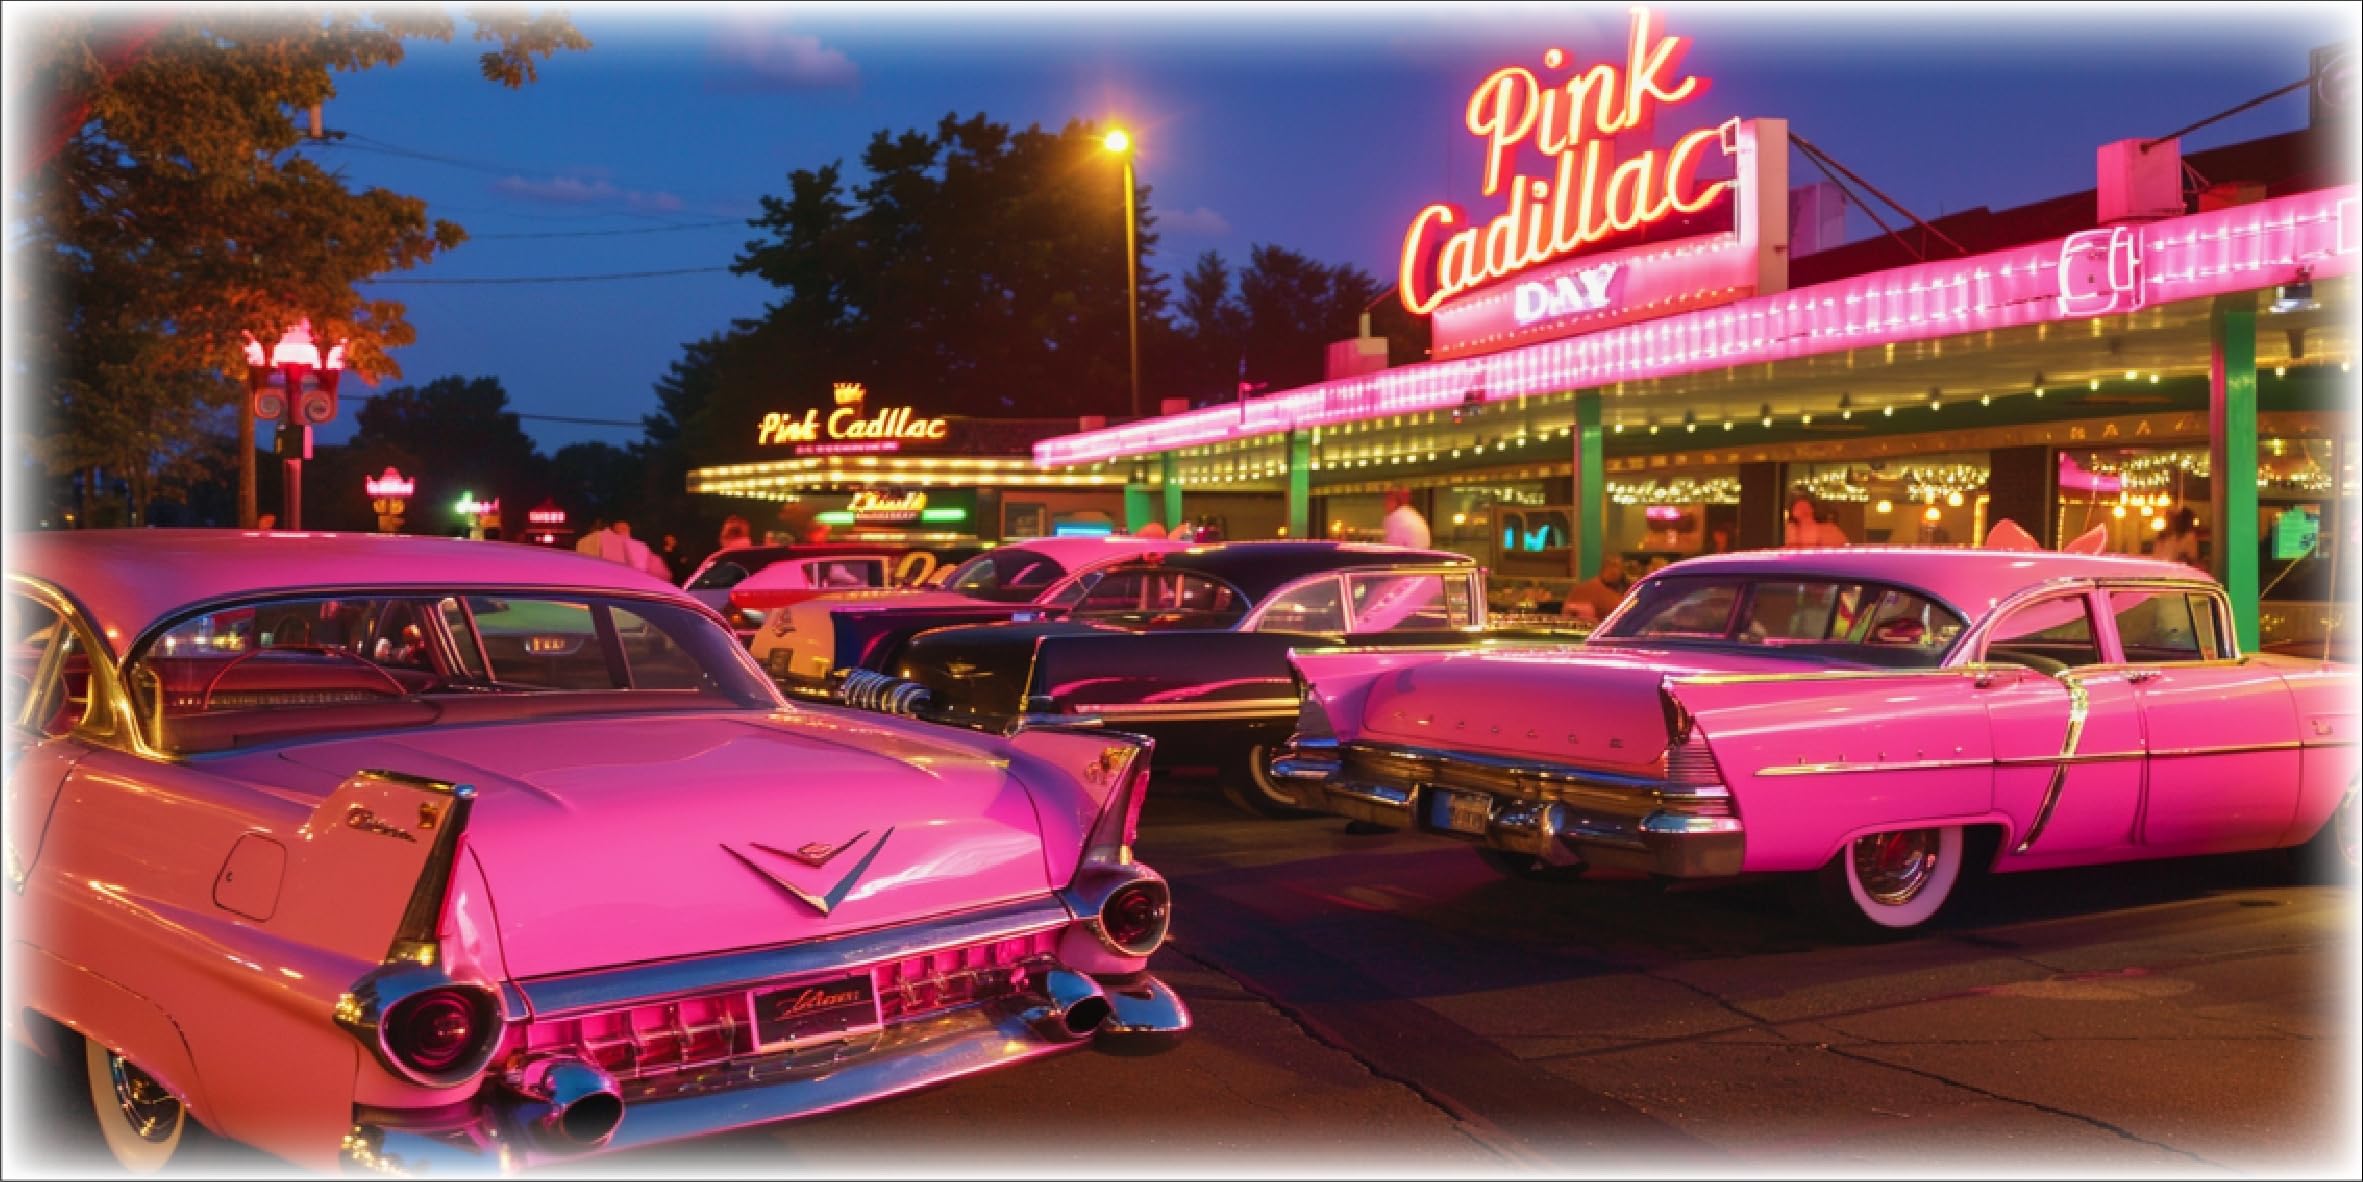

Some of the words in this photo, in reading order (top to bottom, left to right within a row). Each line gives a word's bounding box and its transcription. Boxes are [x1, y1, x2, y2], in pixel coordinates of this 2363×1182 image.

[1465, 5, 1704, 196] Pink
[1400, 129, 1735, 315] Cadillac
[1513, 262, 1622, 324] DAY
